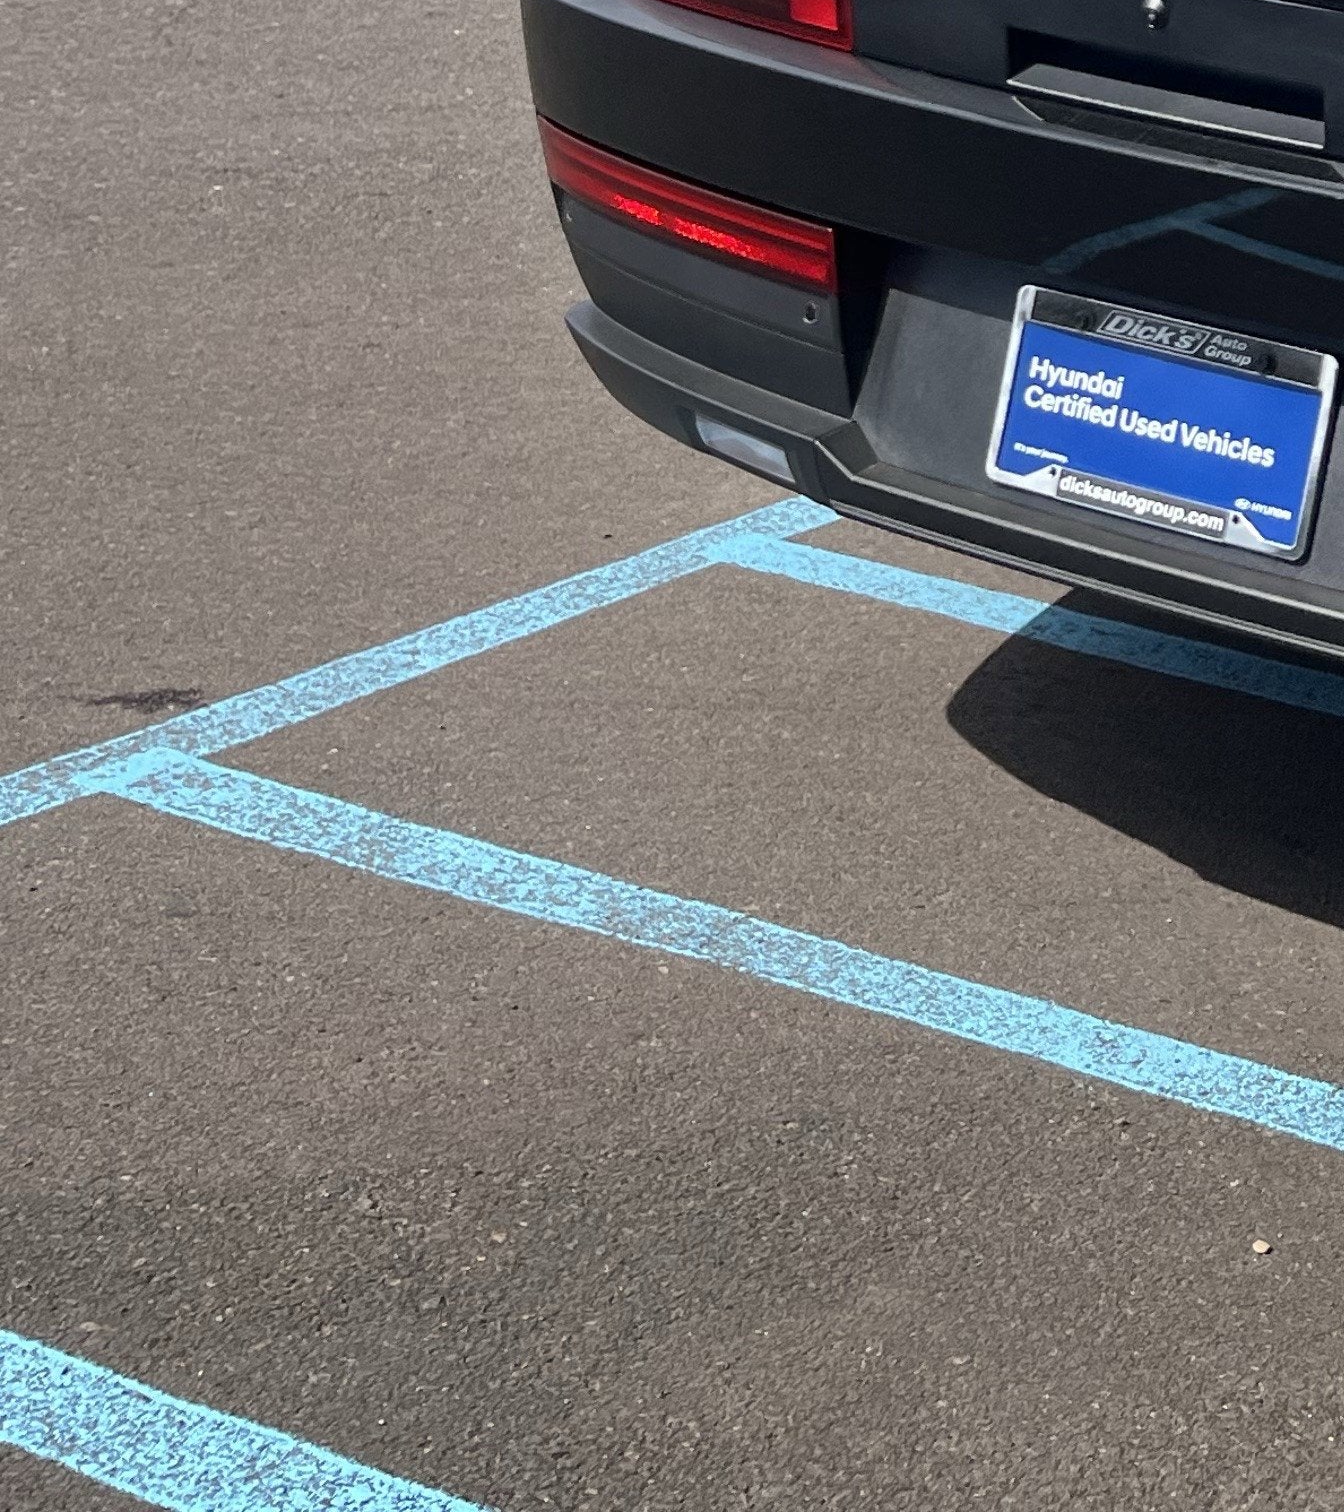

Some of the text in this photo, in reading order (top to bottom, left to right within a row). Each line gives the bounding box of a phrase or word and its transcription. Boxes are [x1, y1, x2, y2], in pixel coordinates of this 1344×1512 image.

[1104, 313, 1194, 351] Dick's
[1210, 334, 1249, 352] Auto
[1204, 344, 1252, 367] Group
[1029, 355, 1126, 400] Hyundai
[1023, 384, 1276, 468] Certified Used Vehicles
[1058, 474, 1226, 533] dicksautogroup.com
